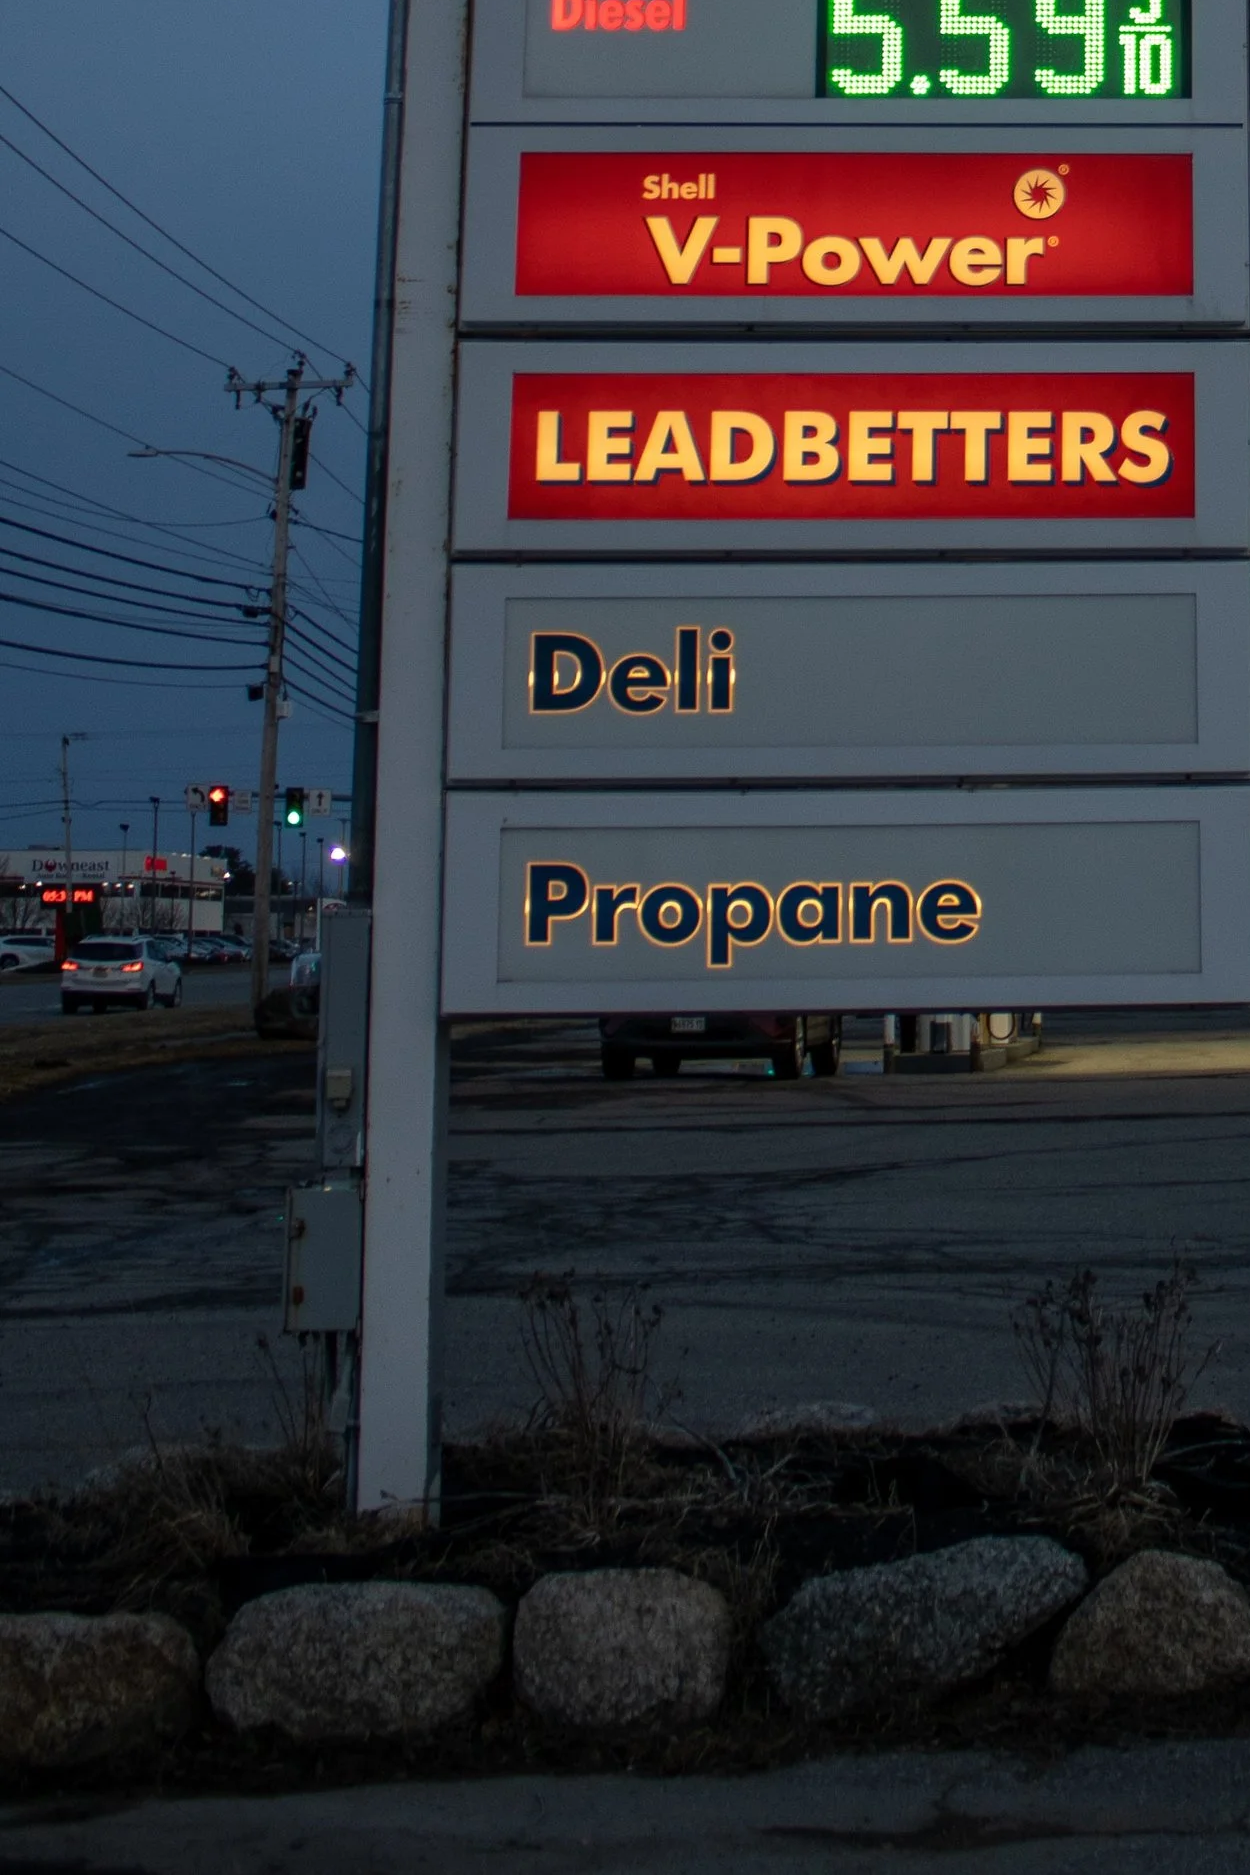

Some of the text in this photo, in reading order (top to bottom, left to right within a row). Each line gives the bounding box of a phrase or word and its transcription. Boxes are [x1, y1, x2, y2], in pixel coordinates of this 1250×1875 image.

[642, 173, 716, 200] Shell
[644, 215, 1045, 287] V-Power
[535, 410, 1174, 488] LEADBETTERS
[527, 625, 737, 715] Deli
[74, 889, 94, 902] PM
[523, 862, 983, 970] Propane
